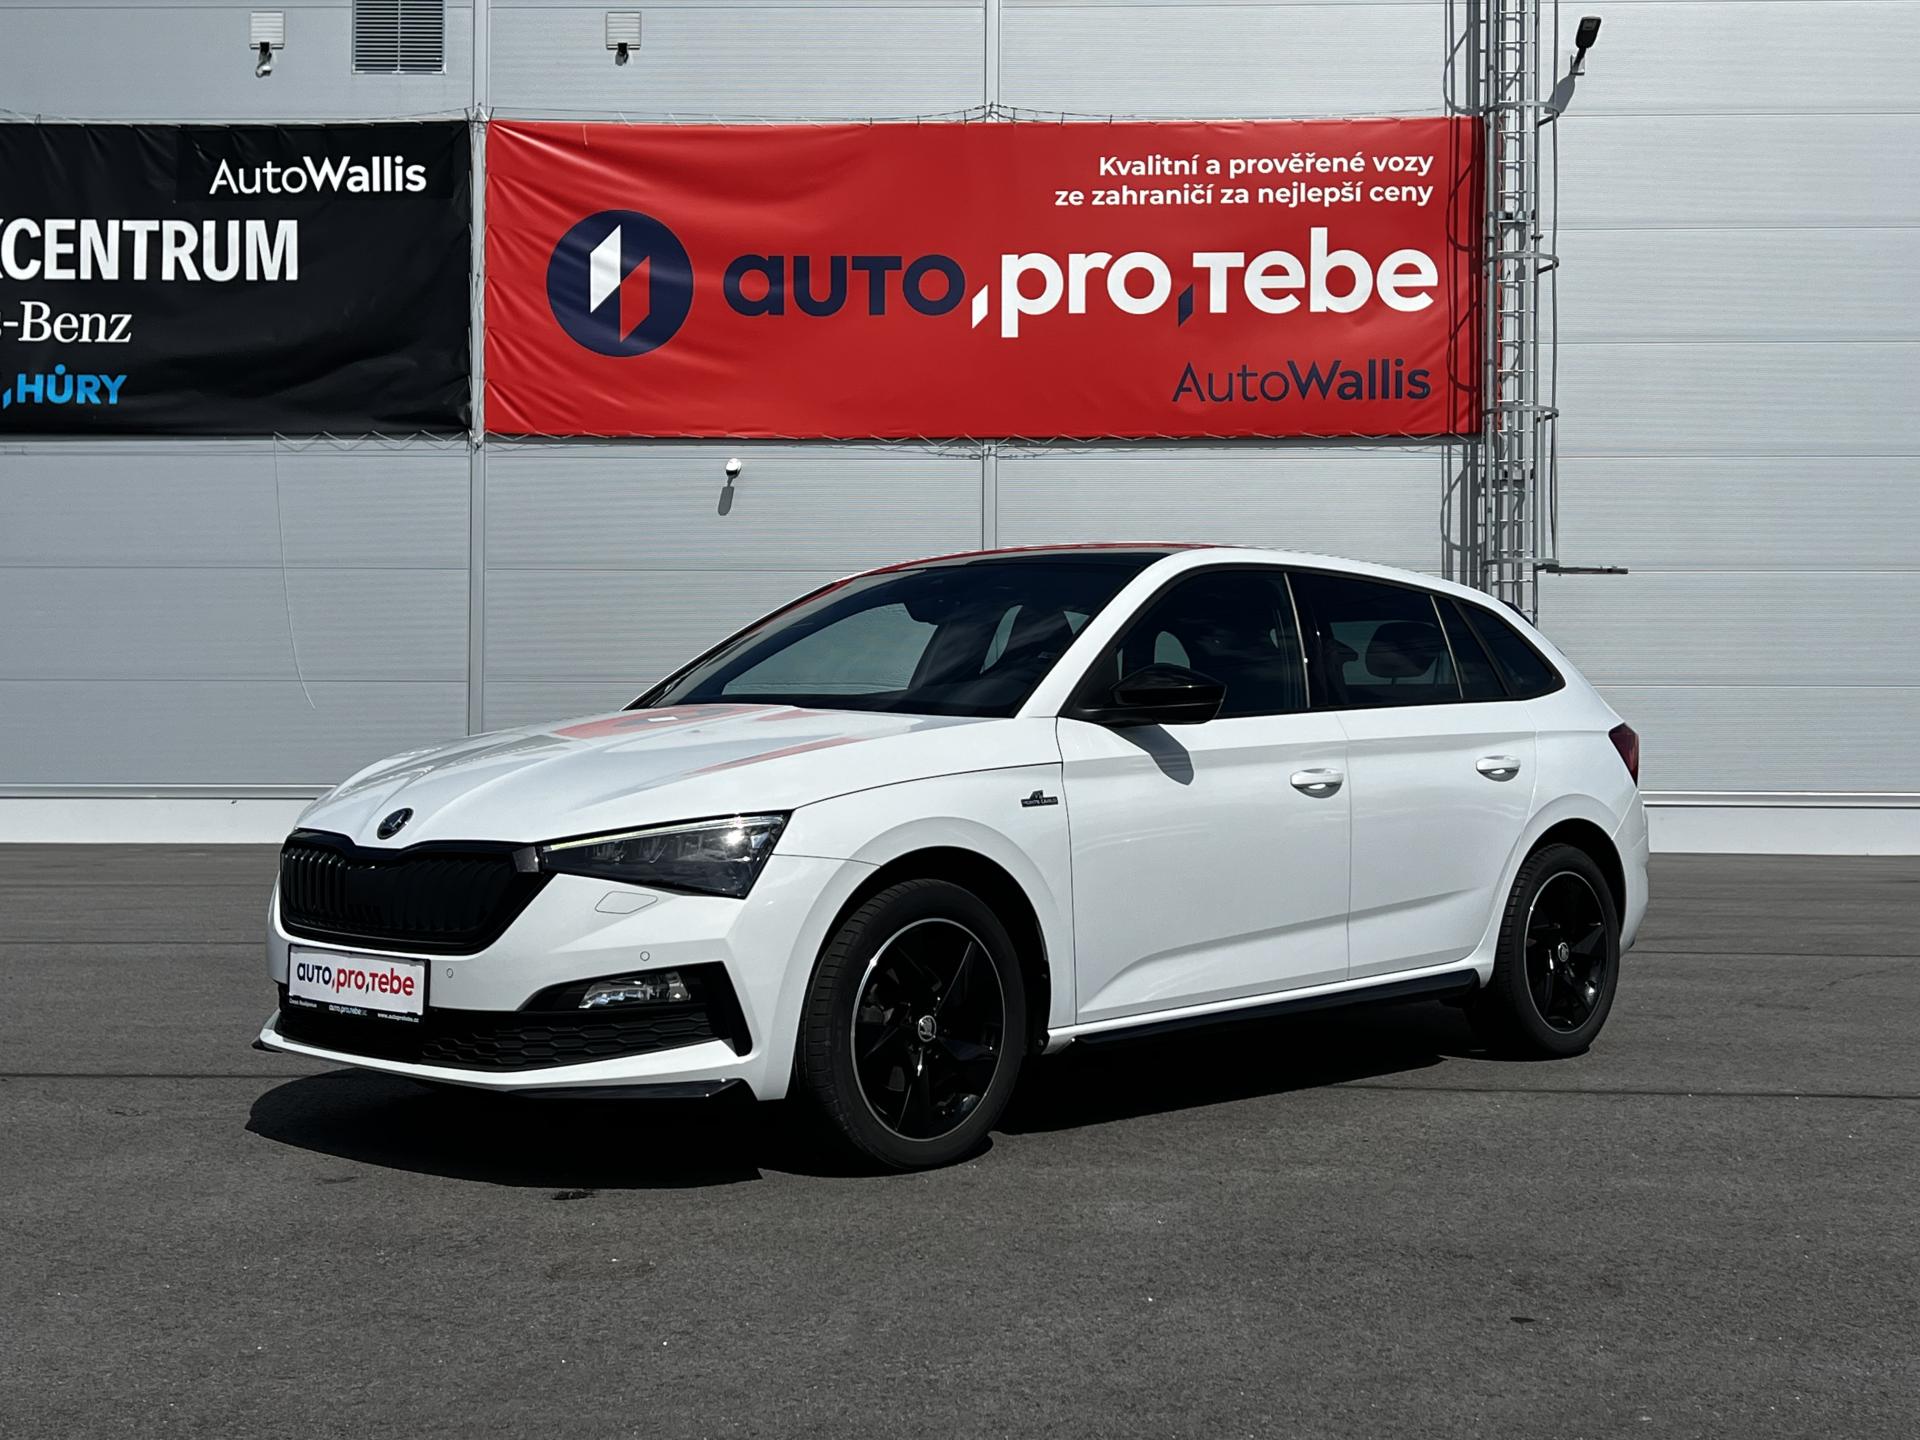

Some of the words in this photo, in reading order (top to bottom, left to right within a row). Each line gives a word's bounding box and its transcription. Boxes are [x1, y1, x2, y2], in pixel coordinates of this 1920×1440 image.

[209, 155, 427, 195] AutoWallis
[1098, 154, 1199, 176] Kvalitní
[1205, 161, 1222, 175] a
[1228, 152, 1366, 179] prověřené
[1372, 153, 1434, 174] vozy
[1054, 190, 1085, 206] ze
[1091, 183, 1214, 206] zahraničí
[1220, 187, 1250, 204] za
[1258, 181, 1362, 208] nejlepší
[1369, 184, 1434, 205] ceny
[0, 217, 299, 282] CENTRUM
[0, 300, 133, 344] -Benz
[1172, 358, 1432, 403] AutoWallis
